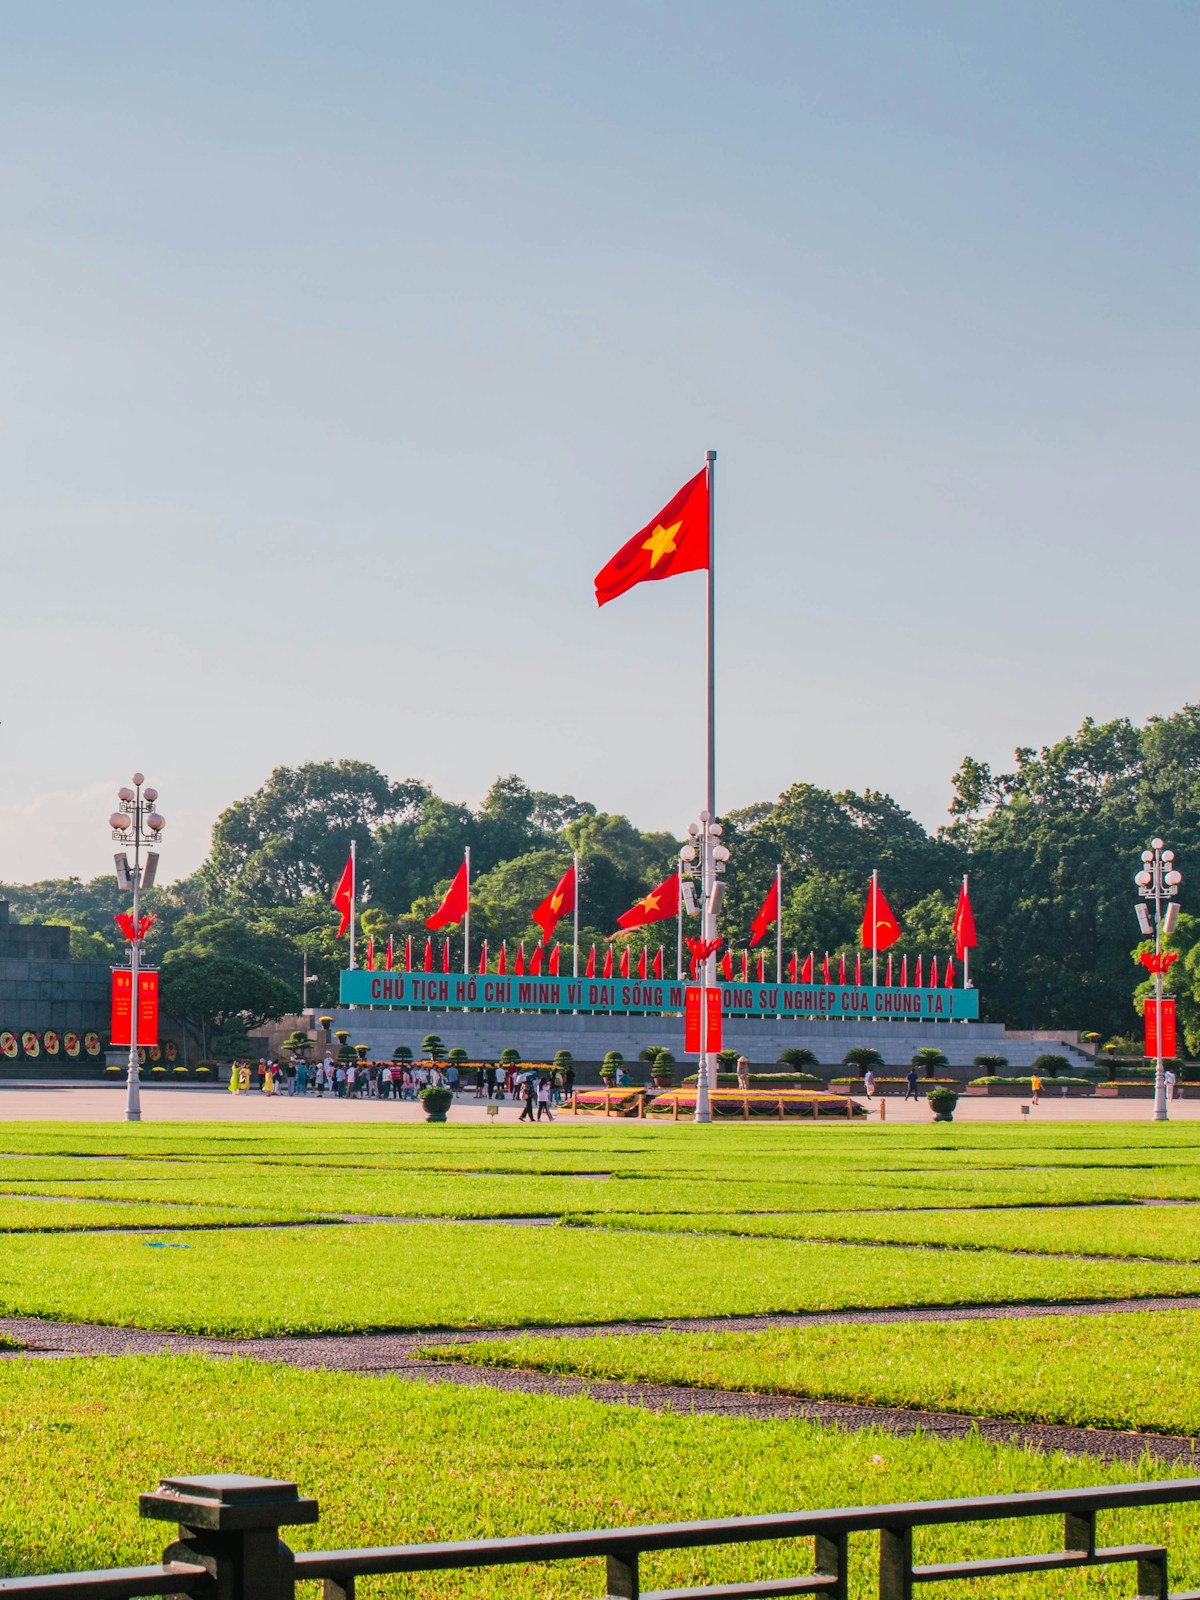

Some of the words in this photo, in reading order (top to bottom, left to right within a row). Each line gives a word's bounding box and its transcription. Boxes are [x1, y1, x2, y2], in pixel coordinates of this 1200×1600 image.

[371, 973, 405, 1000] CHỦ
[412, 979, 449, 1005] TỊCH
[456, 975, 478, 1002] HỒ
[484, 978, 512, 1003] CHÍ
[518, 983, 561, 1005] MINH
[567, 981, 583, 1005] VĨ
[589, 985, 615, 1009] ĐẠI
[621, 980, 664, 1007] SỐNG
[723, 989, 753, 1009] ONG
[759, 988, 780, 1013] SỰ
[784, 987, 836, 1014] NGHIỆP
[841, 986, 870, 1012] CỦA
[875, 990, 922, 1013] CHÚNG
[927, 994, 944, 1014] TA
